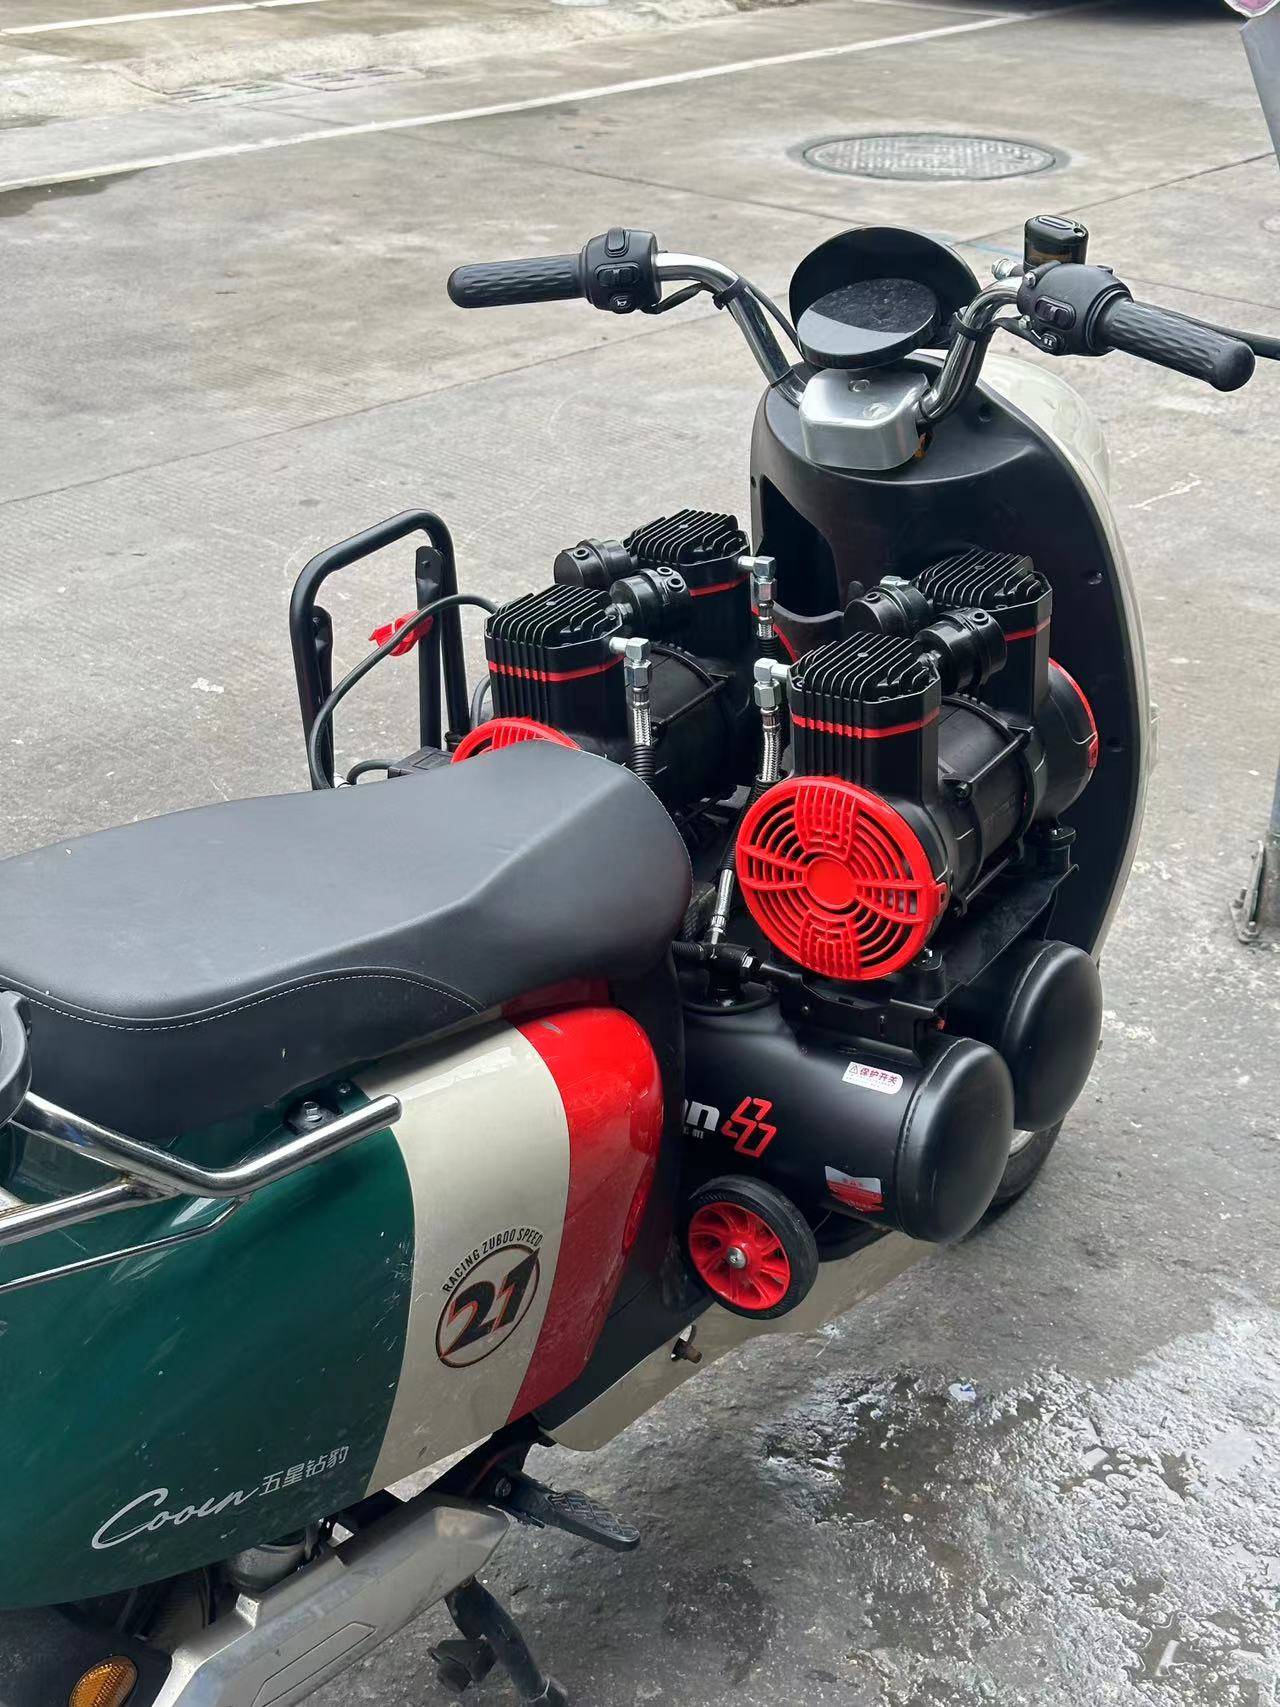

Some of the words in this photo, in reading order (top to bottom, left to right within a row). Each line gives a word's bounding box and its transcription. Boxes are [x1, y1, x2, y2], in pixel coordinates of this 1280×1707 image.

[860, 1067, 898, 1085] 保护开关
[442, 1249, 480, 1292] RACING
[482, 1228, 516, 1253] ZUBOO
[517, 1227, 543, 1247] SPEED
[441, 1247, 540, 1357] 21
[259, 1445, 349, 1496] 五星钻豹
